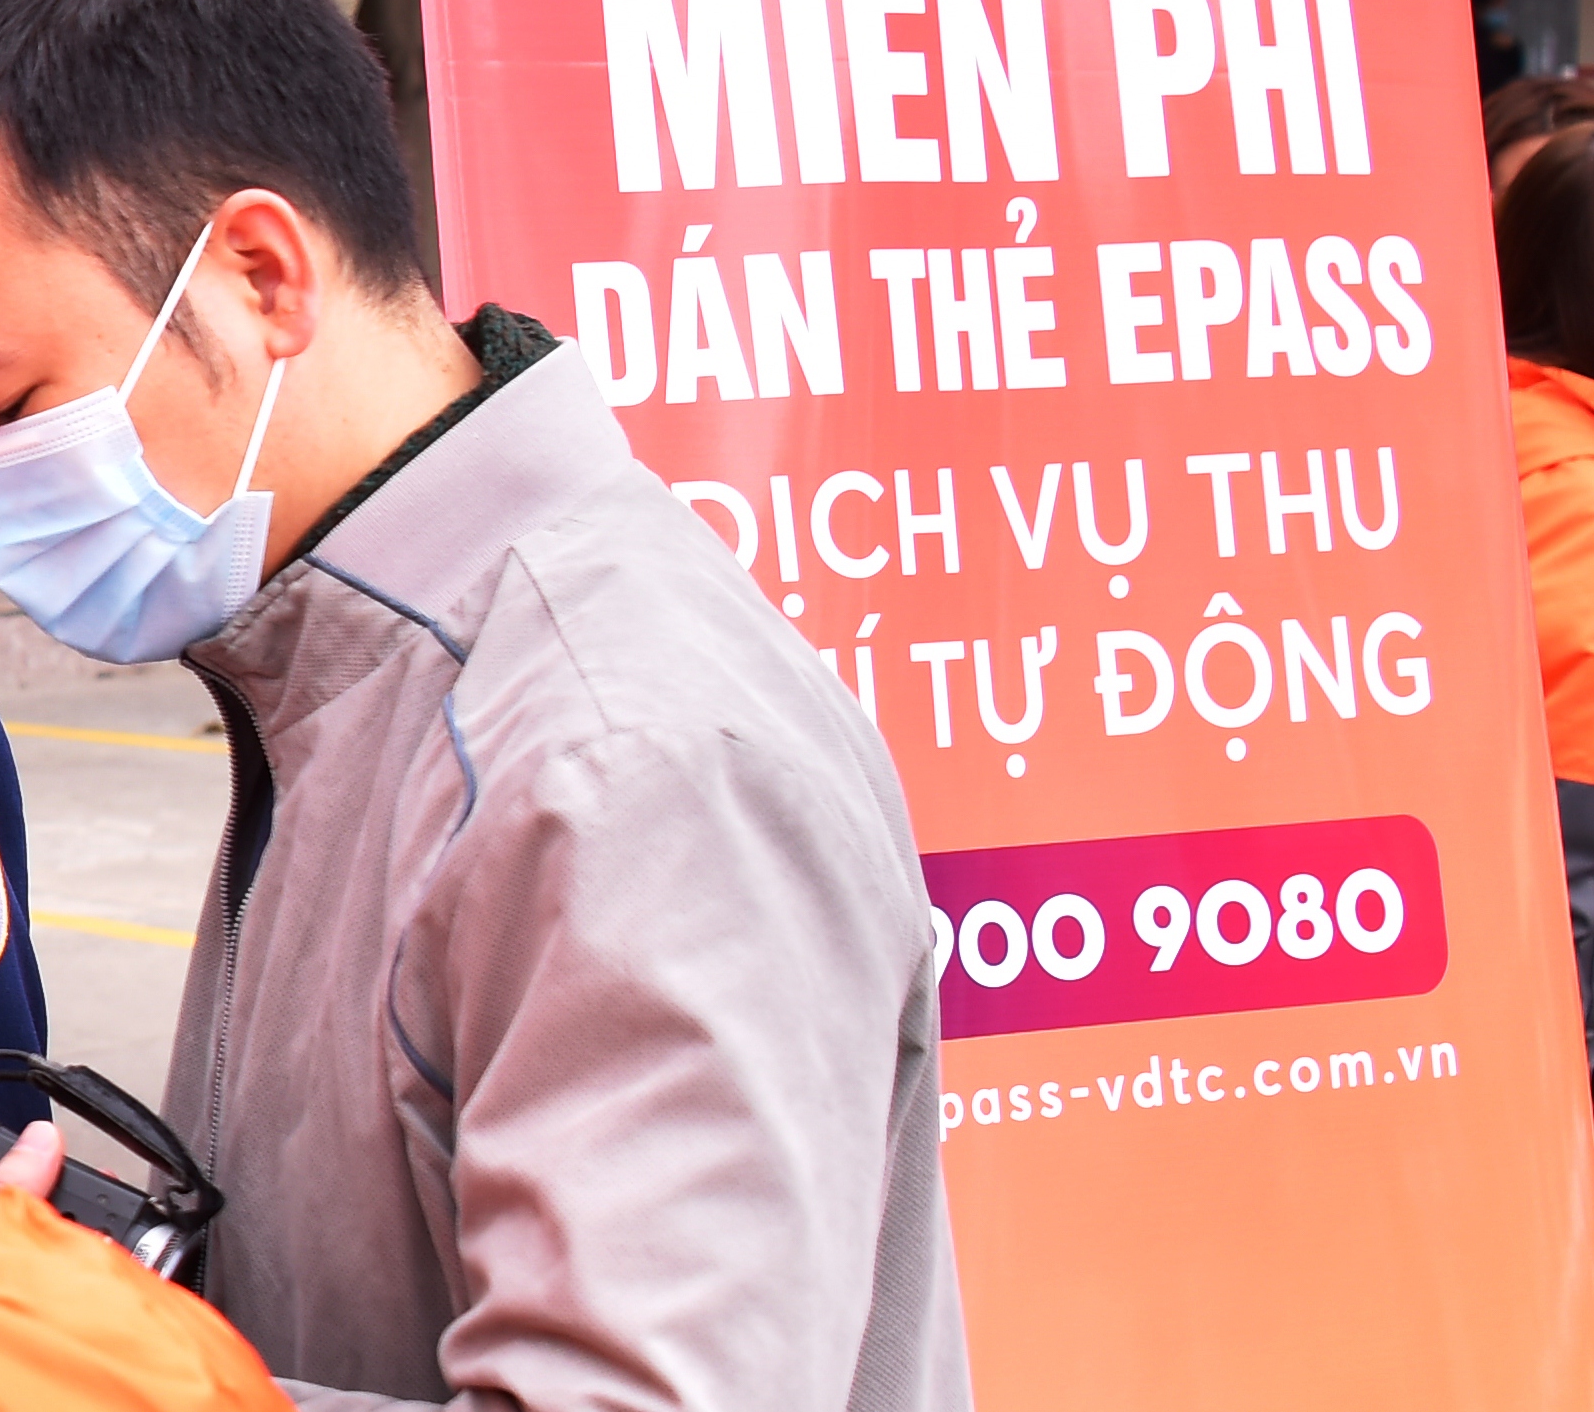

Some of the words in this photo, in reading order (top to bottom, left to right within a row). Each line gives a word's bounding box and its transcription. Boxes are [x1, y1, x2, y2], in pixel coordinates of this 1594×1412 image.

[571, 224, 845, 407] DÁN
[869, 197, 1067, 392] THẺ
[1097, 235, 1433, 385] EPASS
[671, 468, 961, 618] DỊCH
[990, 459, 1149, 599] VỤ
[1186, 447, 1400, 558] THU
[910, 626, 1058, 778] TỰ
[1094, 593, 1432, 762] ĐỘNG
[1133, 868, 1404, 972] 9080
[938, 1042, 1458, 1143] pass-vdtc.com.vn
